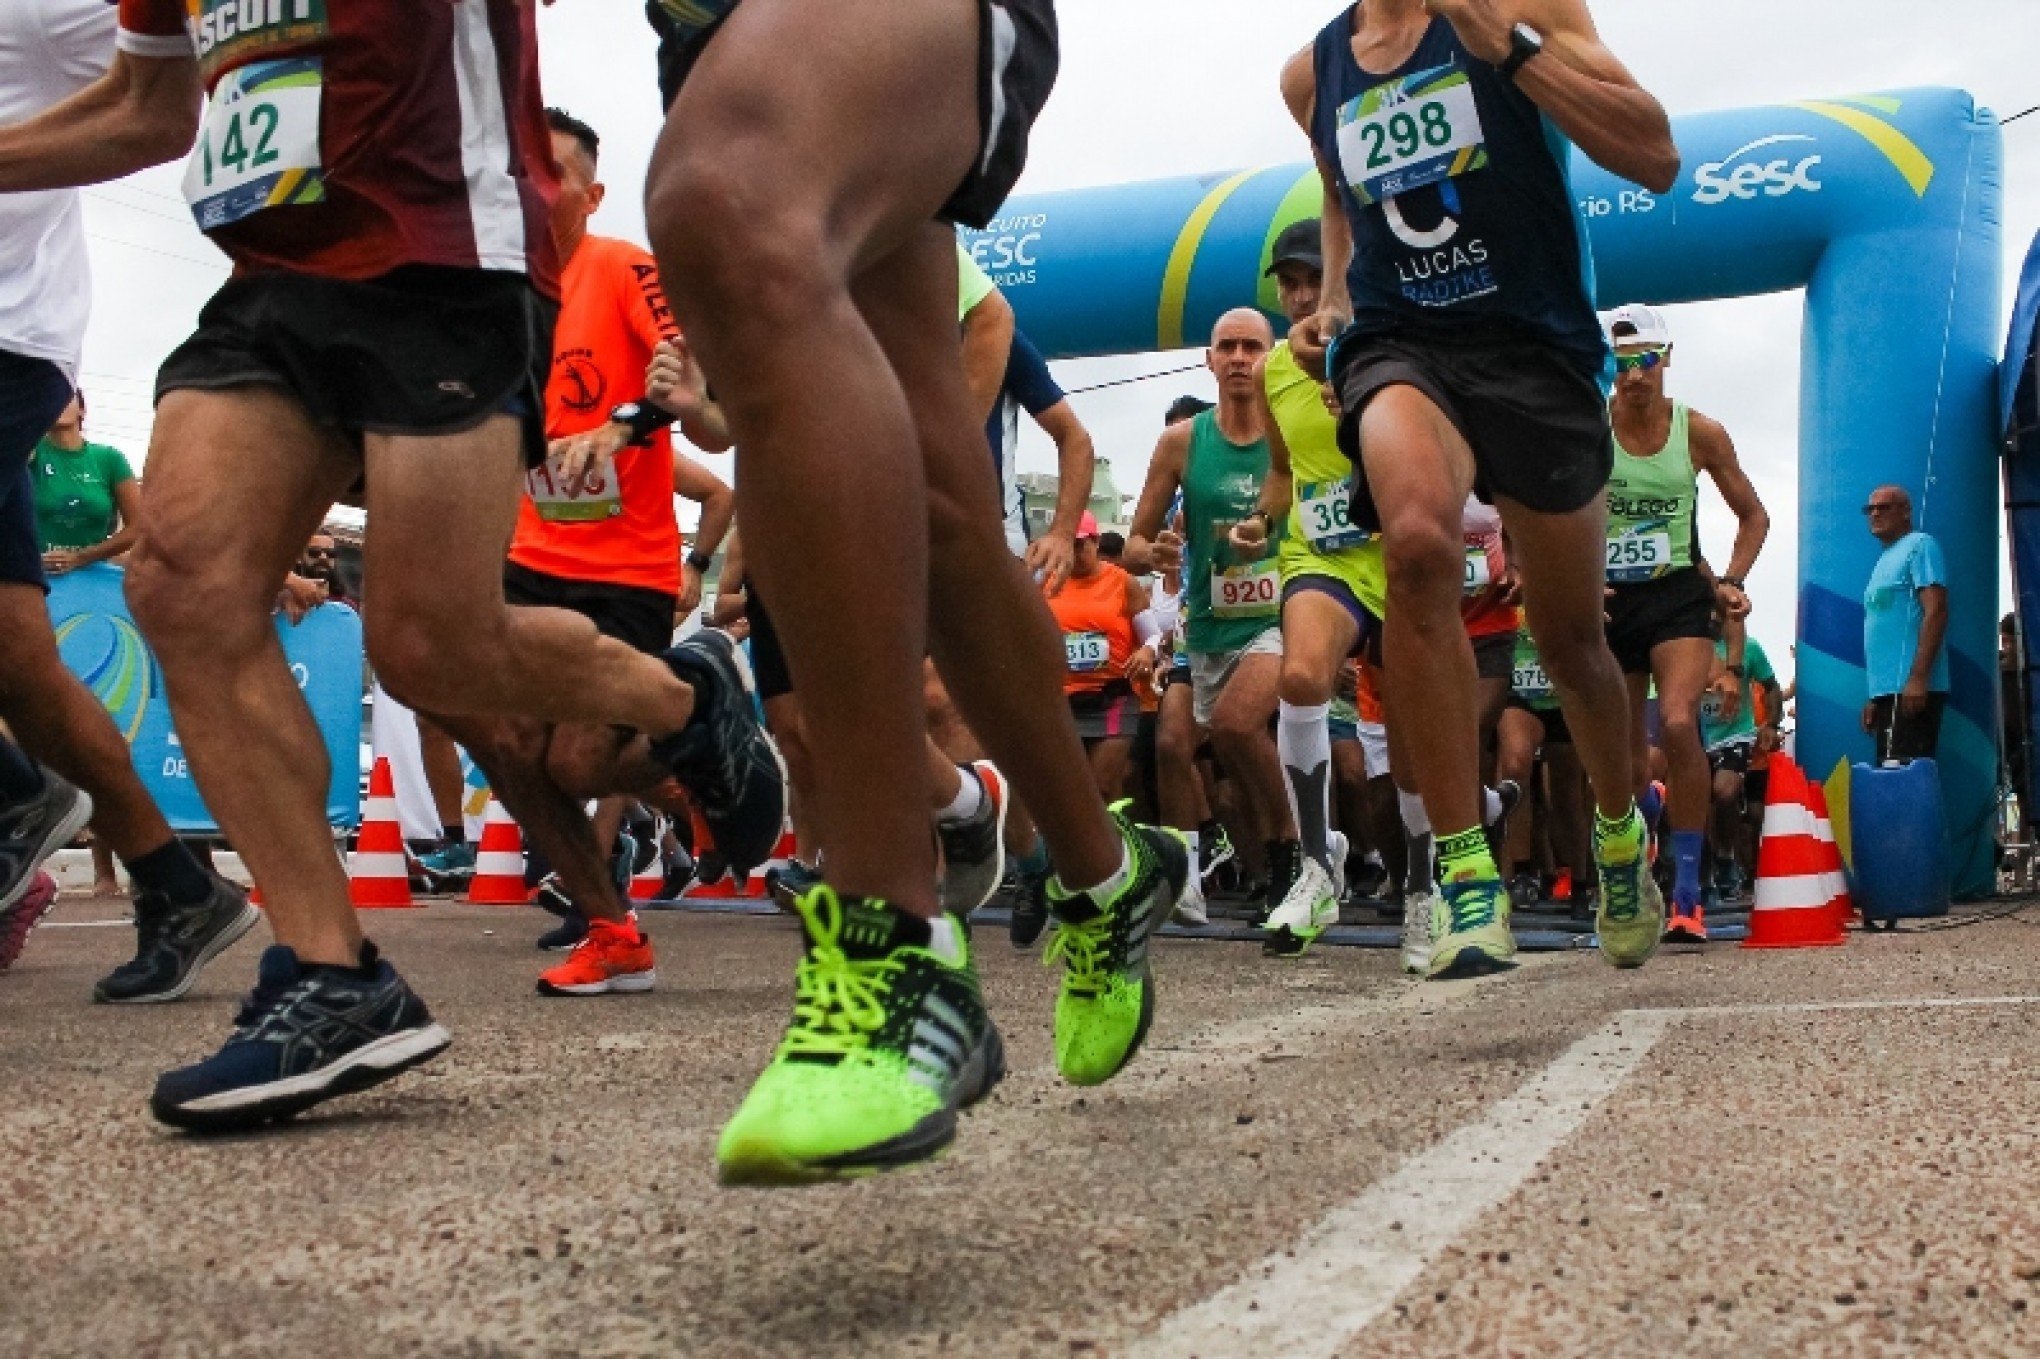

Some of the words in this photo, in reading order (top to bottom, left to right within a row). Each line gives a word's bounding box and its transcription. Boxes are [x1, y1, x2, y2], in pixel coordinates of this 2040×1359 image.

[202, 102, 279, 187] 142
[1361, 101, 1452, 170] 298
[1618, 189, 1656, 214] RS
[966, 231, 1042, 270] ESC
[1394, 238, 1488, 283] LUCAS
[1608, 538, 1656, 564] 255
[1223, 578, 1274, 605] 920
[163, 757, 187, 778] DE
